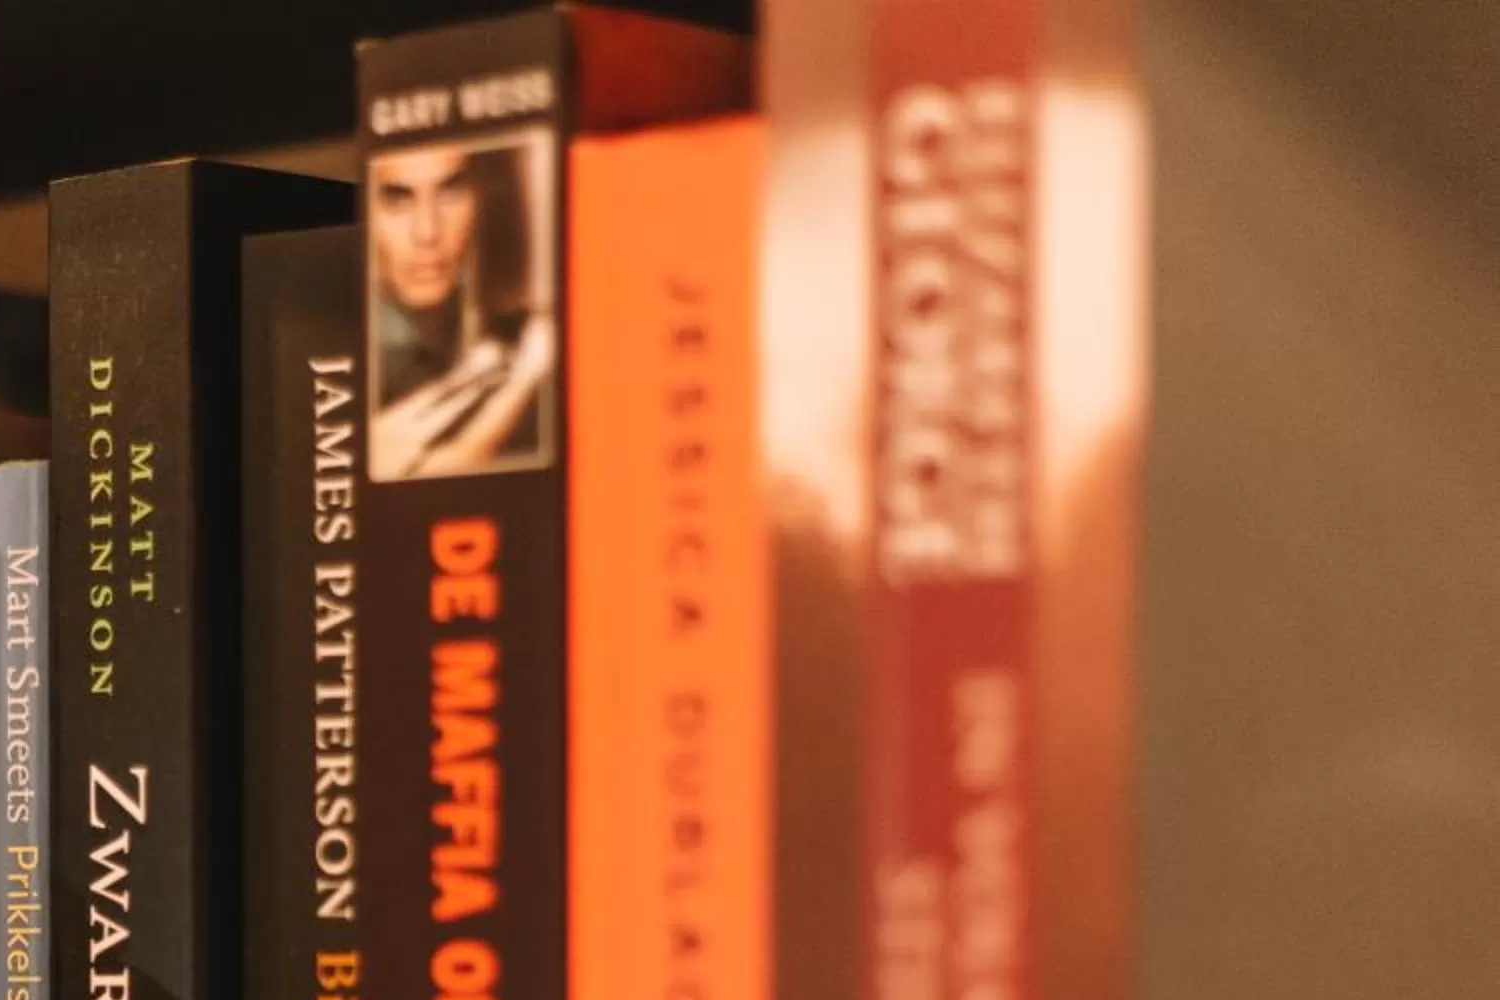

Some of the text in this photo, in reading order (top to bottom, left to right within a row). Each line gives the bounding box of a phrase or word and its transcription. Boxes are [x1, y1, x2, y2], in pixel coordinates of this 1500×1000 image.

[87, 356, 115, 698] DICKINSON
[127, 442, 154, 605] MATT
[306, 354, 355, 545] JAMES
[5, 544, 40, 651] Mart
[428, 520, 500, 621] DE
[5, 668, 40, 824] Smeets
[312, 563, 355, 922] PATTERSON
[428, 641, 500, 923] MAFFIA
